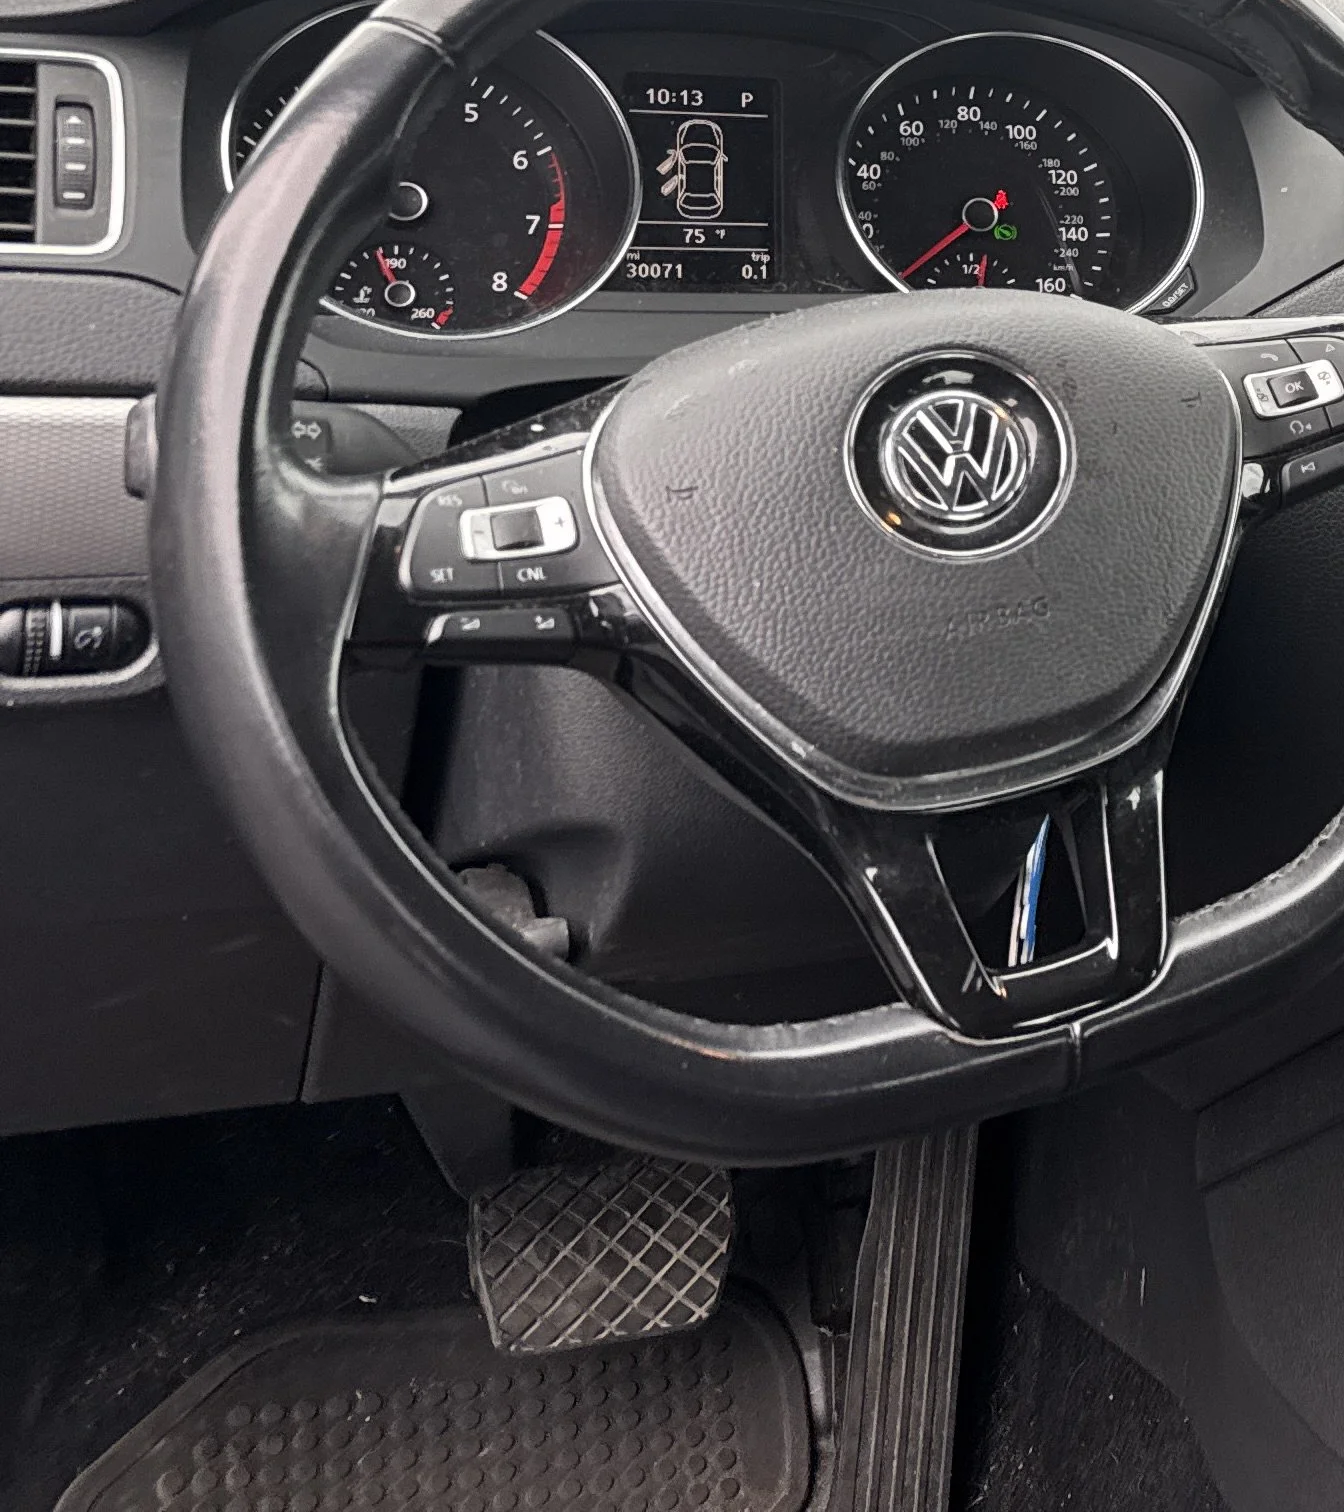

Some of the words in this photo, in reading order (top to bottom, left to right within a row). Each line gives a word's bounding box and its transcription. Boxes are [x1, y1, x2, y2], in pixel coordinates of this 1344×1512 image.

[645, 88, 704, 106] 10:13
[741, 92, 754, 108] P
[464, 104, 479, 122] 5
[956, 106, 981, 122] 80
[900, 120, 924, 136] 60
[938, 119, 958, 129] 120
[979, 121, 998, 131] 140
[1005, 124, 1037, 140] 100
[900, 137, 920, 147] 100
[1018, 140, 1038, 151] 160
[512, 151, 529, 170] 6
[880, 151, 895, 161] 80
[1041, 158, 1061, 168] 180
[856, 163, 881, 180] 40
[1047, 169, 1078, 185] 120
[861, 180, 877, 191] 60
[1059, 186, 1080, 197] 200
[858, 211, 872, 221] 40
[1063, 214, 1084, 225] 220
[525, 215, 541, 234] 7
[683, 228, 706, 244] 75
[1058, 226, 1089, 242] 140
[626, 251, 640, 261] mi
[751, 251, 771, 263] trip
[1059, 247, 1079, 258] 240
[384, 257, 407, 269] 190
[961, 263, 981, 275] 1/2
[626, 263, 683, 279] 30071
[741, 264, 768, 280] 0.1
[491, 271, 508, 292] 8
[1035, 277, 1067, 293] 160
[411, 307, 436, 320] 260
[1284, 380, 1304, 394] OK
[430, 567, 454, 584] SET
[516, 566, 547, 583] CNL
